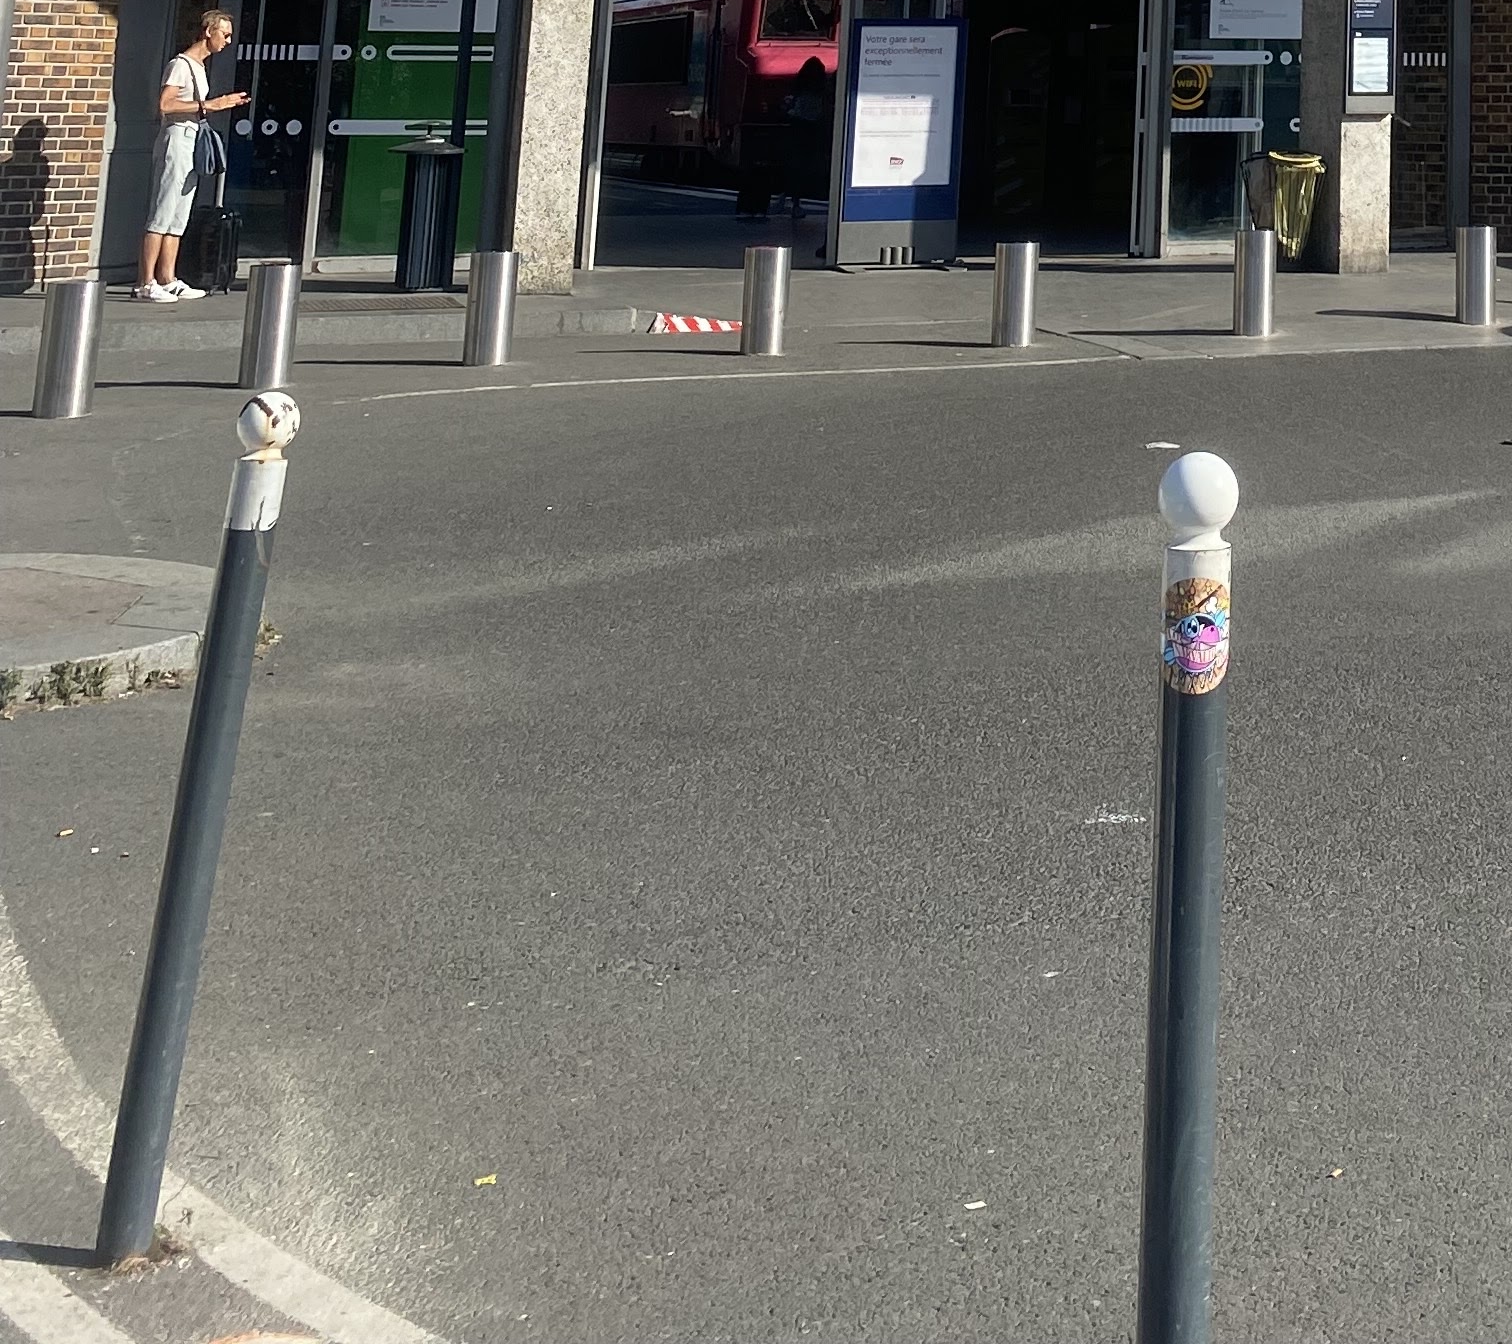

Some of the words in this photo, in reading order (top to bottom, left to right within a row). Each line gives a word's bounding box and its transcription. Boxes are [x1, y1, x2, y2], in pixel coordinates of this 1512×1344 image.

[866, 35, 888, 44] Votre
[889, 36, 908, 46] gare
[909, 36, 926, 44] sera
[865, 47, 943, 56] exceptionnellement
